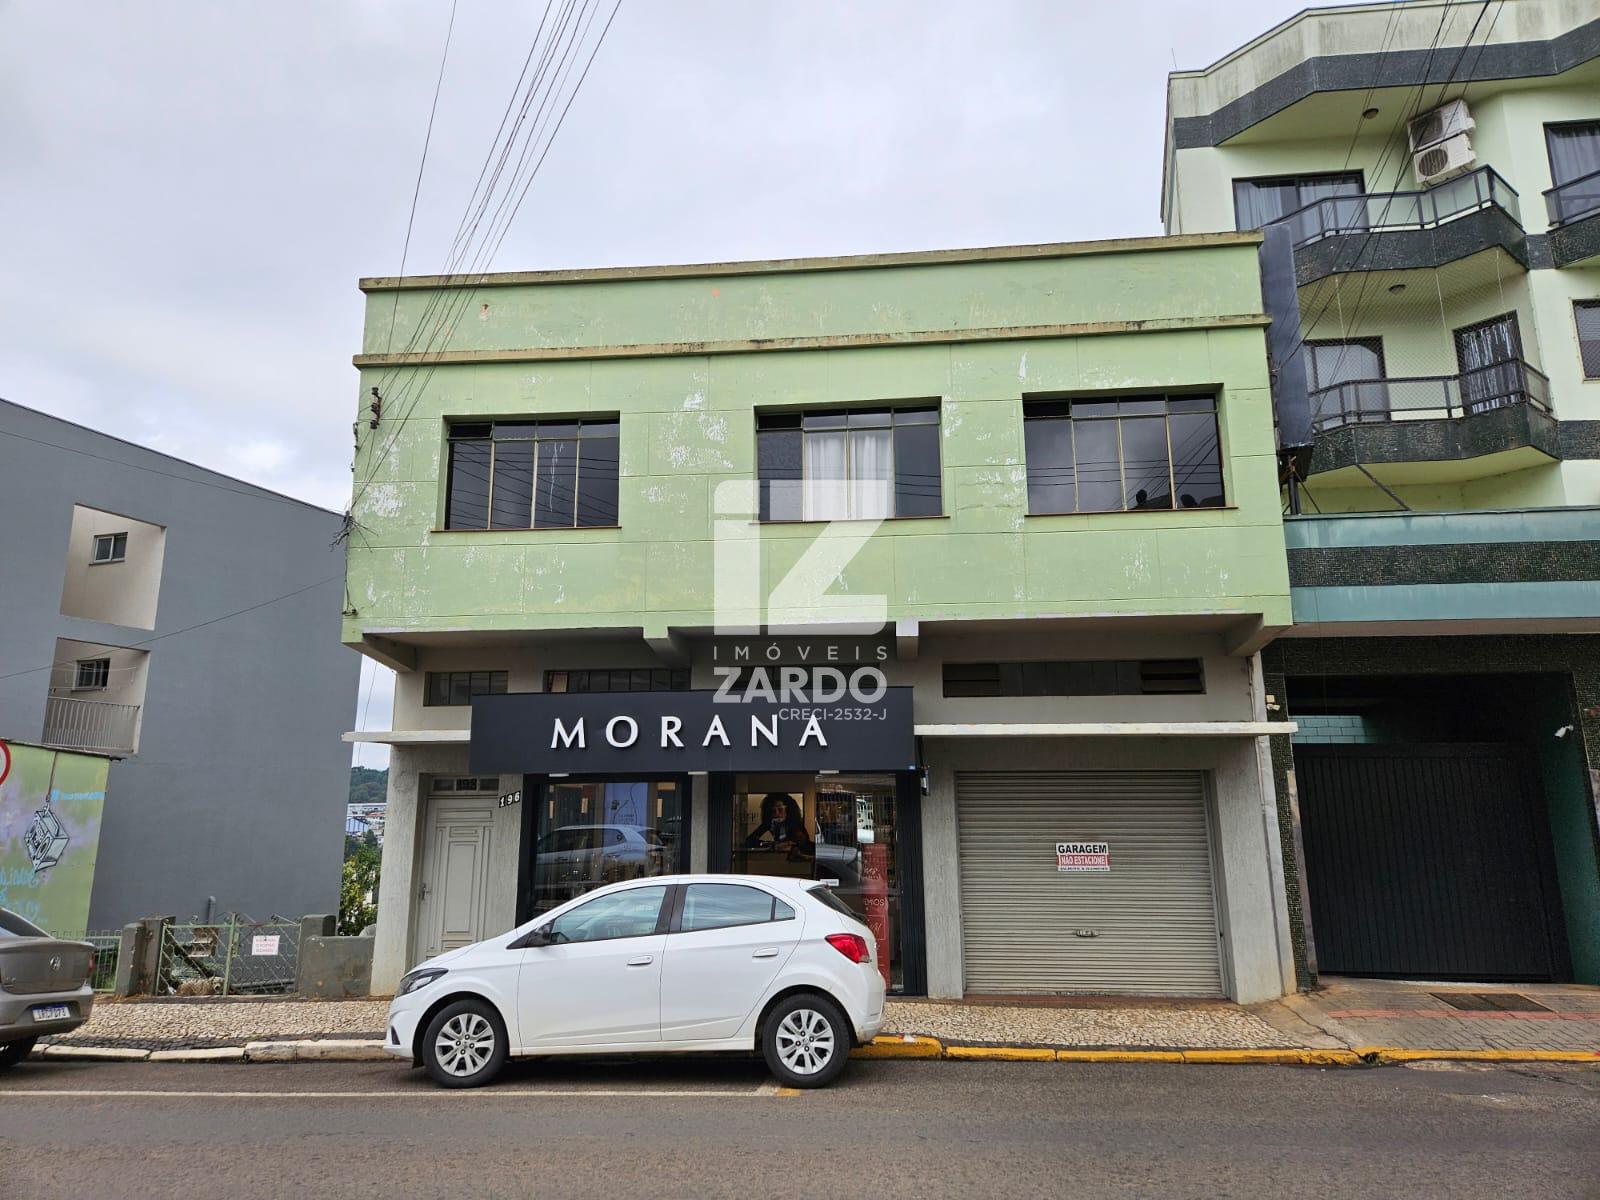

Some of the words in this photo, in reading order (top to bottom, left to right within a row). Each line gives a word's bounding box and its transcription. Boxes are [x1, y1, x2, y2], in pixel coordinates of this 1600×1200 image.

[550, 714, 828, 749] MORANA
[500, 791, 520, 807] 196
[1057, 844, 1107, 854] GARAGEM
[1061, 854, 1074, 865] NÃO
[1074, 855, 1106, 865] ESTACIONE
